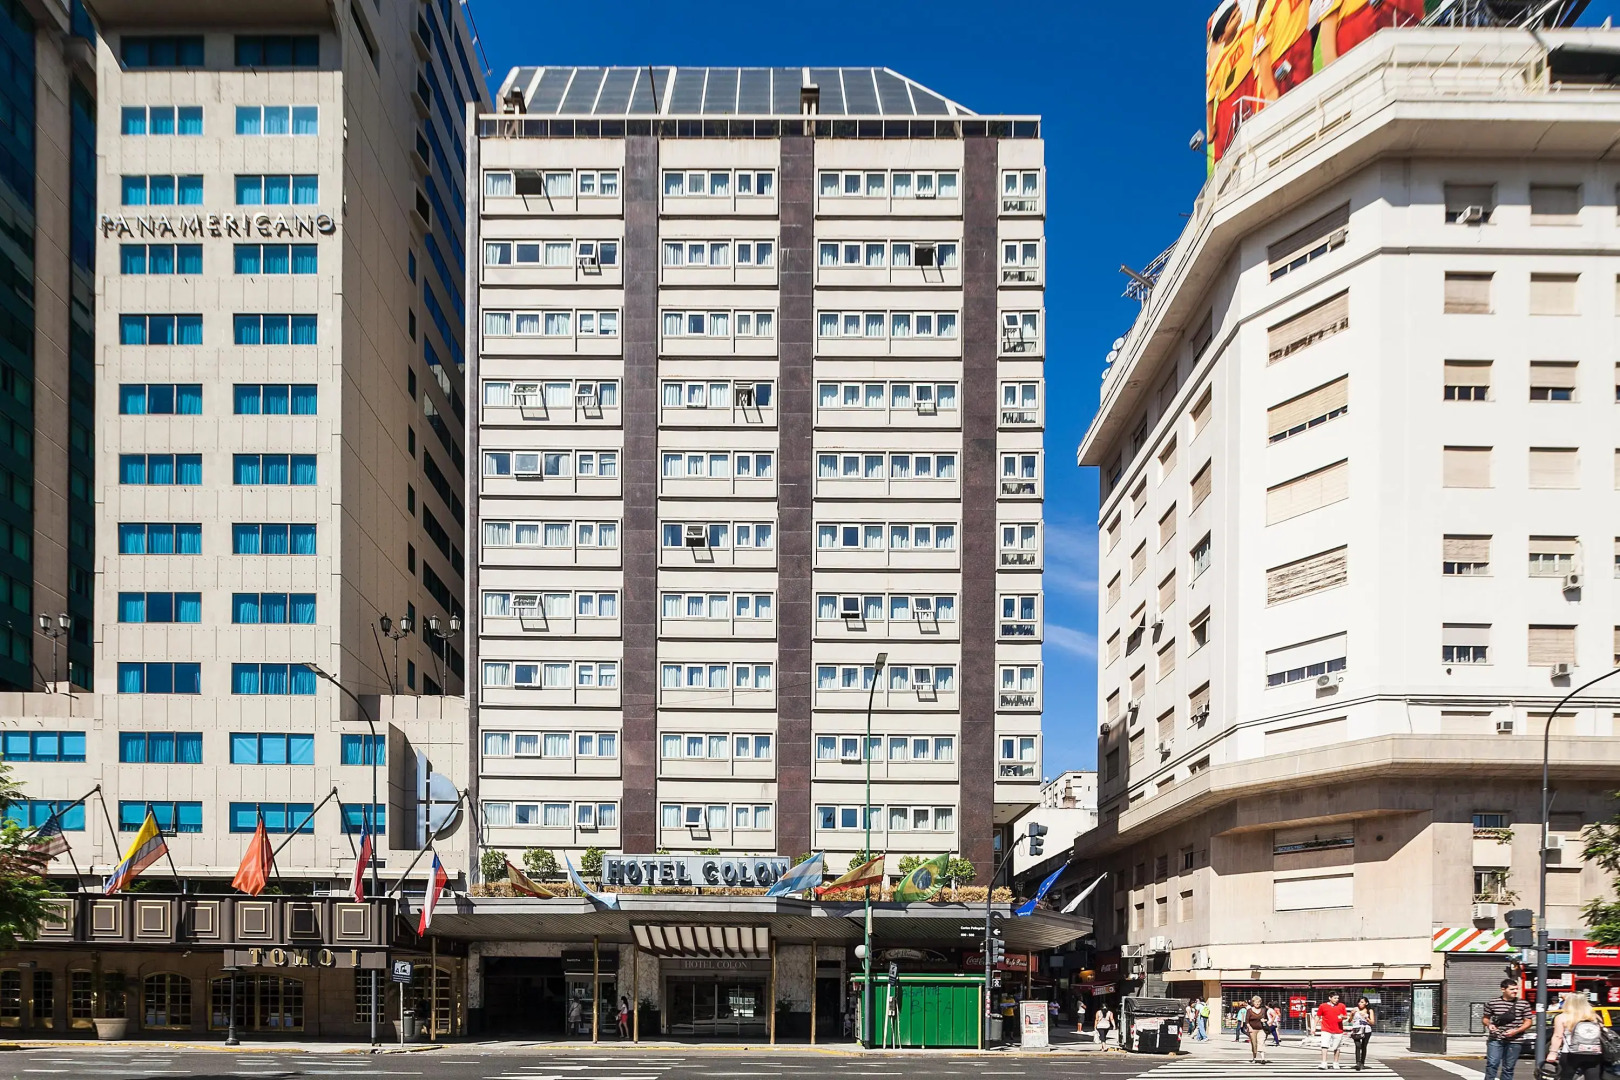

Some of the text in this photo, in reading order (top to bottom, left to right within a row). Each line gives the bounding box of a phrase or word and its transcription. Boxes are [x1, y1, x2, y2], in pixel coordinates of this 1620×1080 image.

[97, 212, 335, 234] PANAMERICANO
[607, 860, 786, 884] HOTEL COLON
[248, 948, 359, 966] TOMO I
[684, 960, 748, 969] HOTEL COLON
